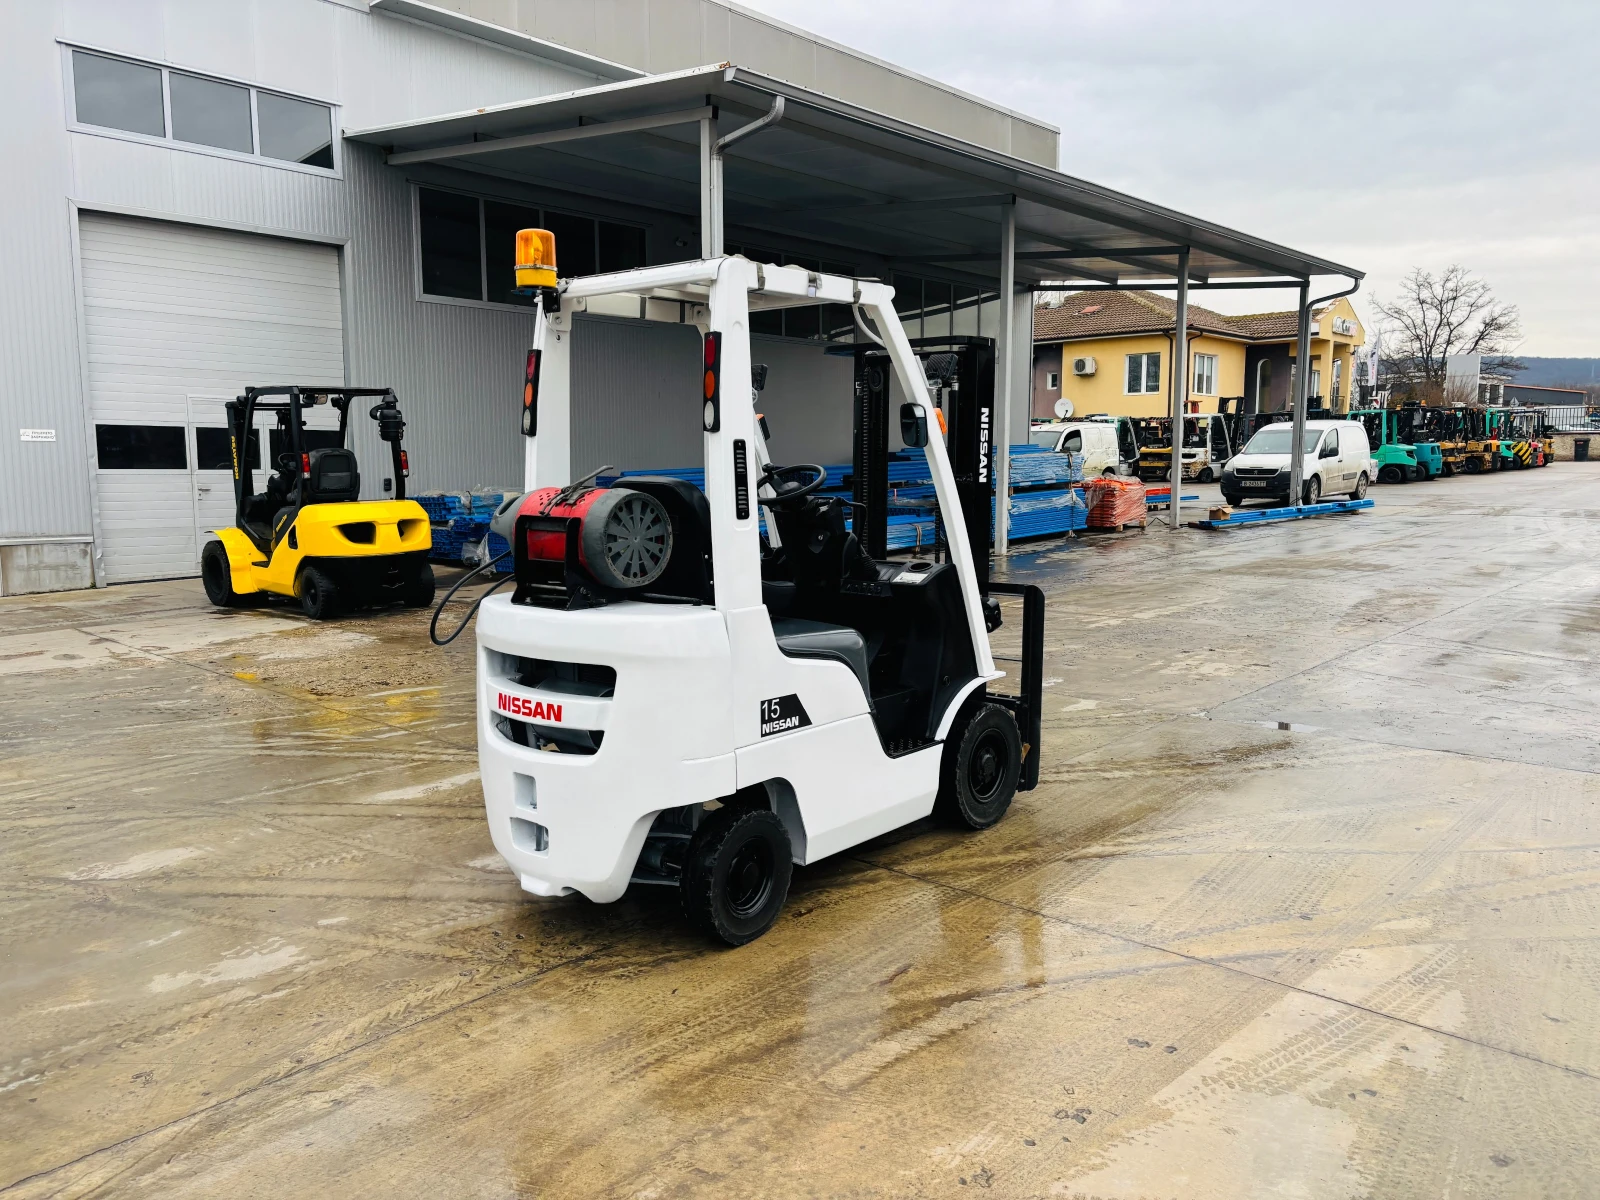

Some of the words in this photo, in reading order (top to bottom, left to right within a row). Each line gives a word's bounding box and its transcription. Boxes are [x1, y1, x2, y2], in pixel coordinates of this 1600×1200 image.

[231, 435, 239, 480] KOMATSU
[979, 407, 989, 483] NISSAN
[498, 692, 562, 722] NISSAN
[762, 698, 780, 720] 15
[762, 715, 799, 735] NISSAN
